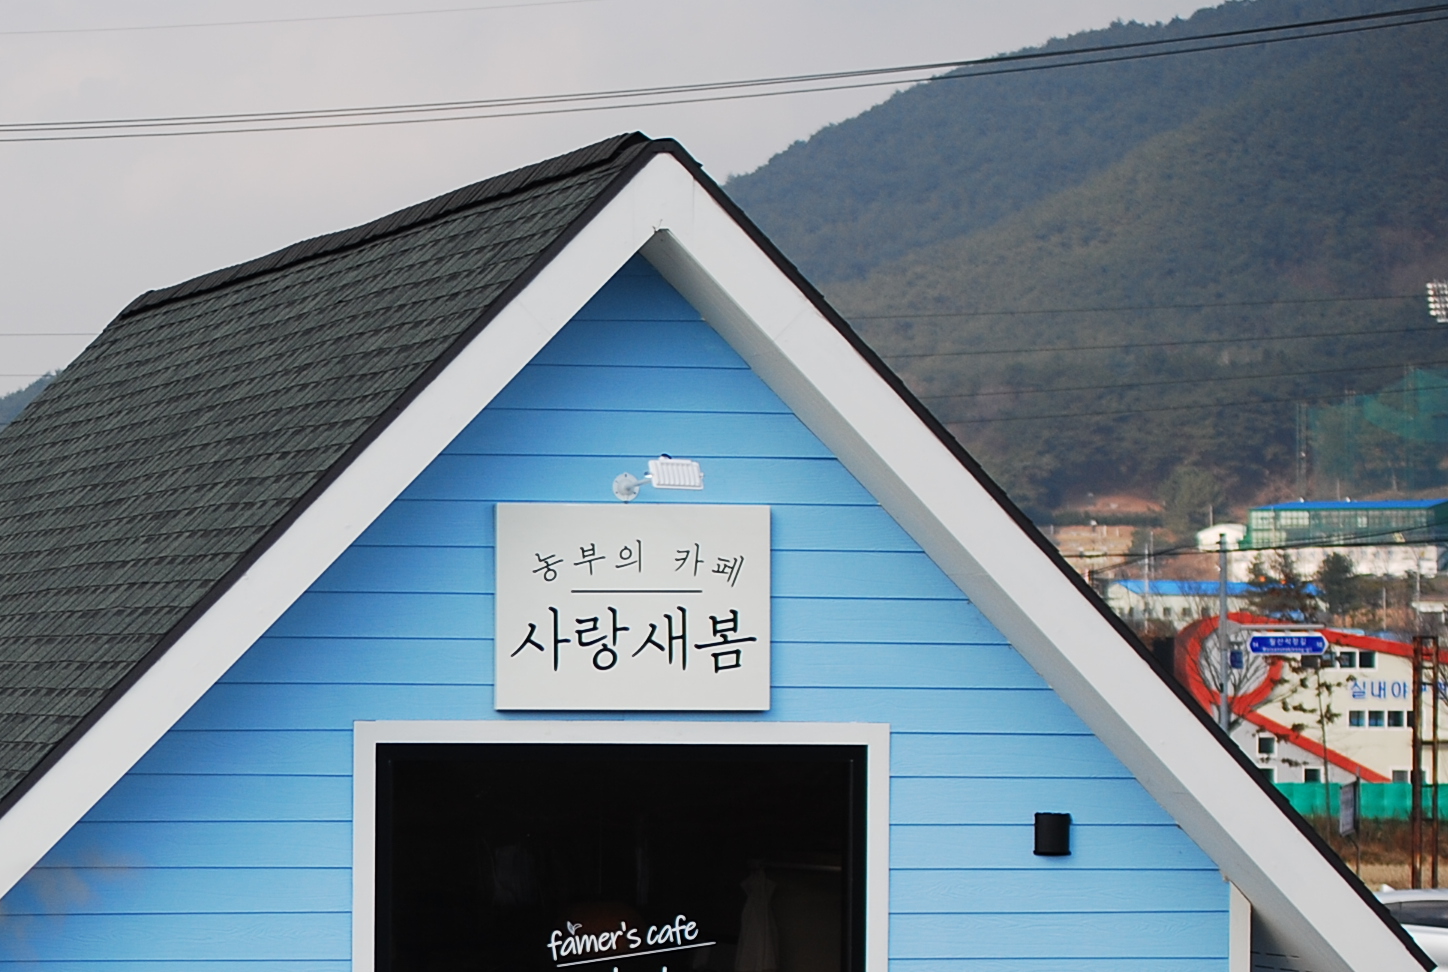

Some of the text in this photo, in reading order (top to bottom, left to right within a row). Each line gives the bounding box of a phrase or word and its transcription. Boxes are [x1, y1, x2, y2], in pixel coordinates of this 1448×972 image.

[532, 539, 745, 587] 농부의 카페
[509, 605, 757, 674] 사랑새봄
[646, 914, 699, 946] cafe
